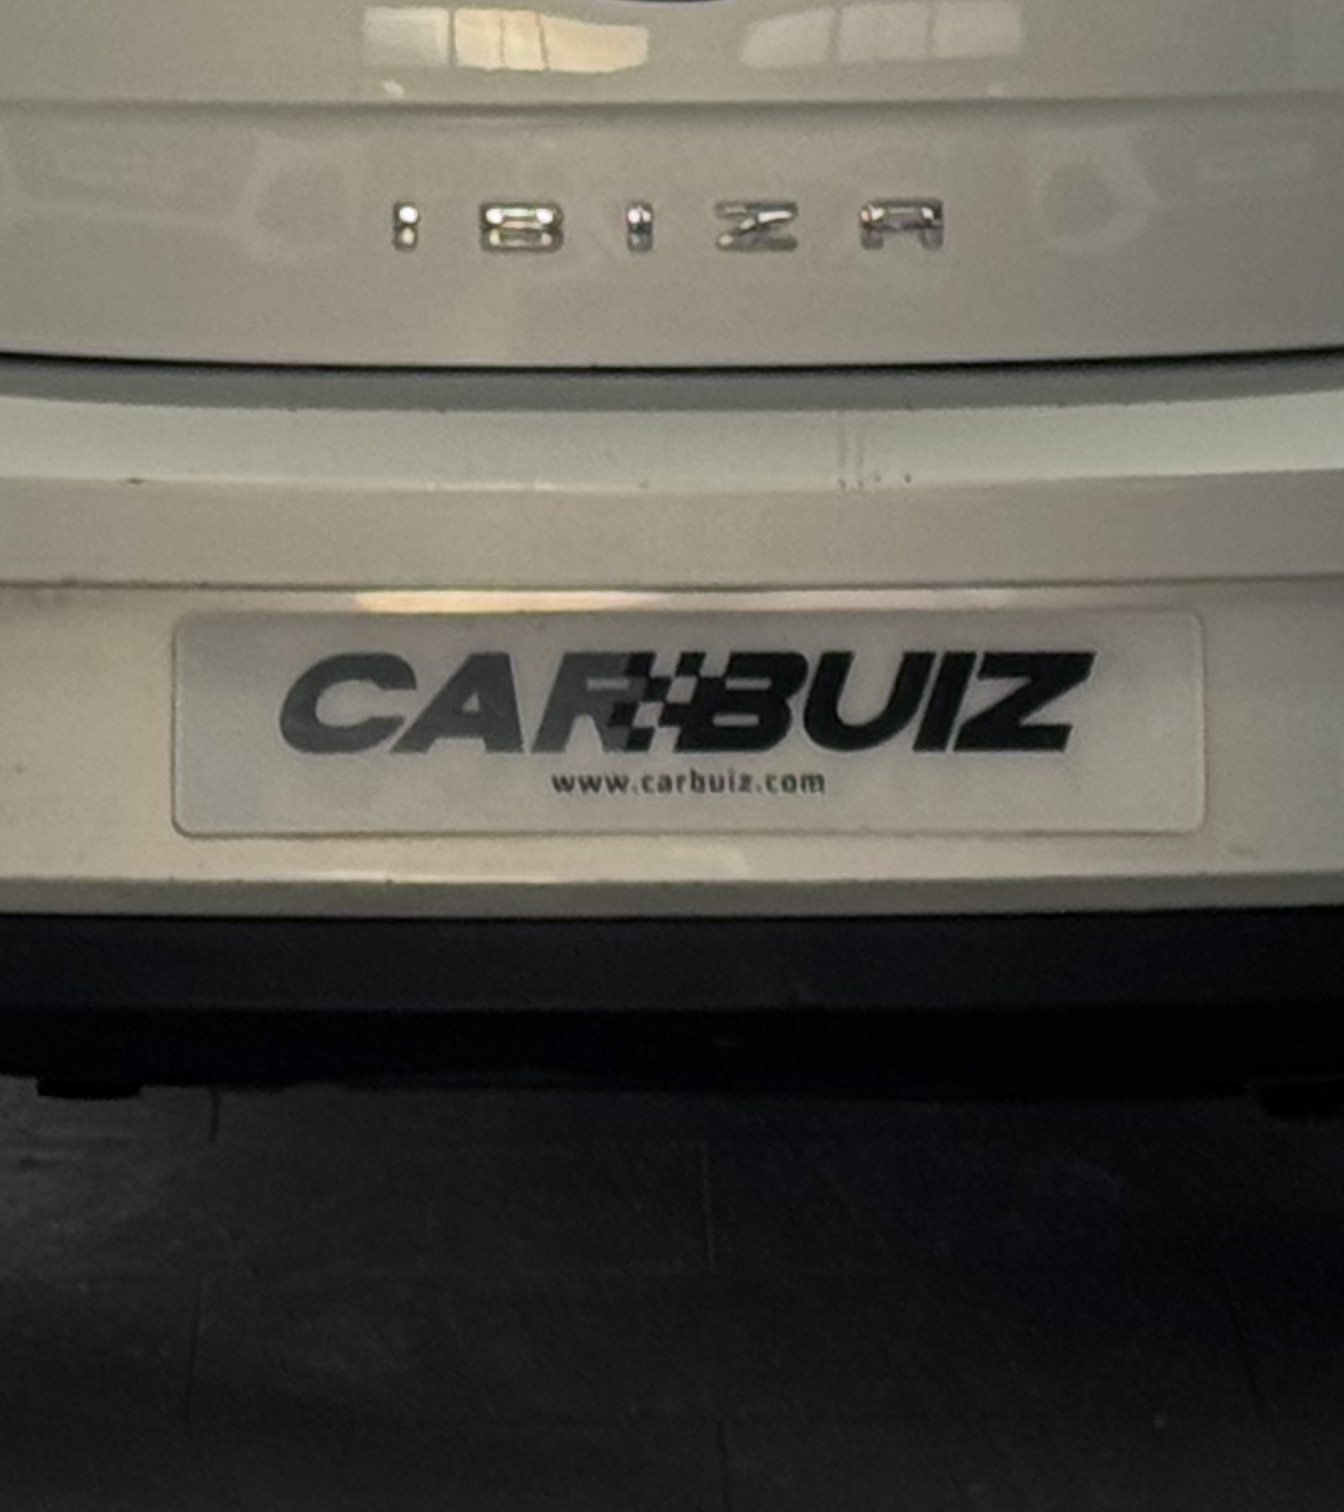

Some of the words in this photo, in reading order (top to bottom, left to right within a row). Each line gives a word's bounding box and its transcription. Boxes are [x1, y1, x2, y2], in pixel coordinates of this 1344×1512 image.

[392, 198, 944, 253] IBIZA
[280, 650, 1097, 755] CARBUIZ
[551, 768, 827, 796] www.carbuiz.com
